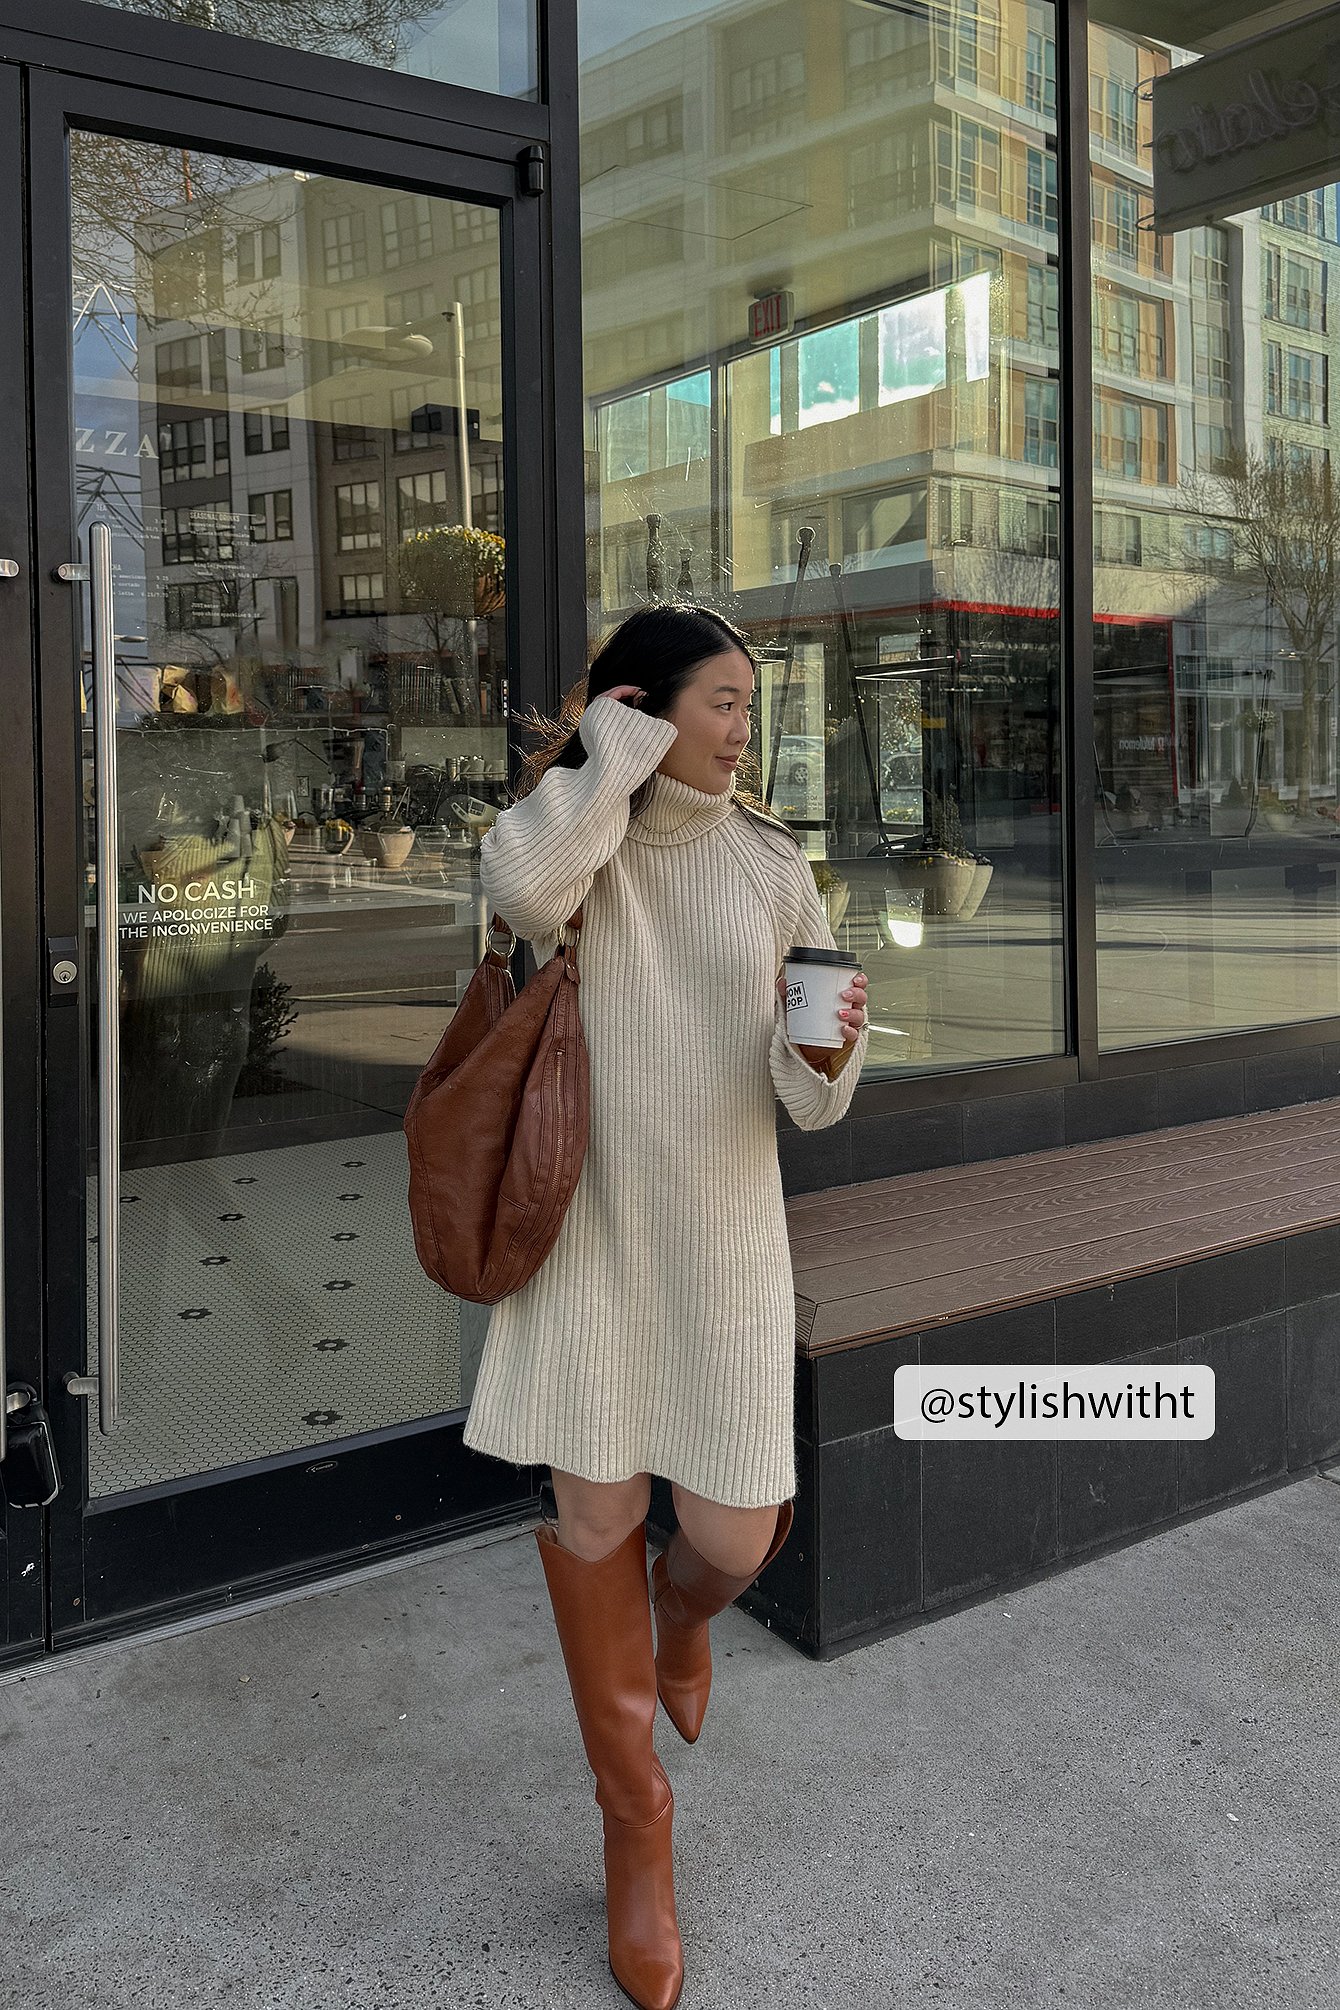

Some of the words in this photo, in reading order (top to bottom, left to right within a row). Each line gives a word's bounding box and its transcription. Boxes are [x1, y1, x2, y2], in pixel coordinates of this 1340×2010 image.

[753, 294, 782, 338] EXIT
[138, 882, 178, 904] NO
[184, 879, 255, 902] CASH
[122, 911, 148, 924] WE
[151, 906, 237, 923] APOLOGIZE
[240, 904, 269, 918] FOR
[119, 926, 149, 939] THE
[152, 918, 273, 938] INCONVENIENCE
